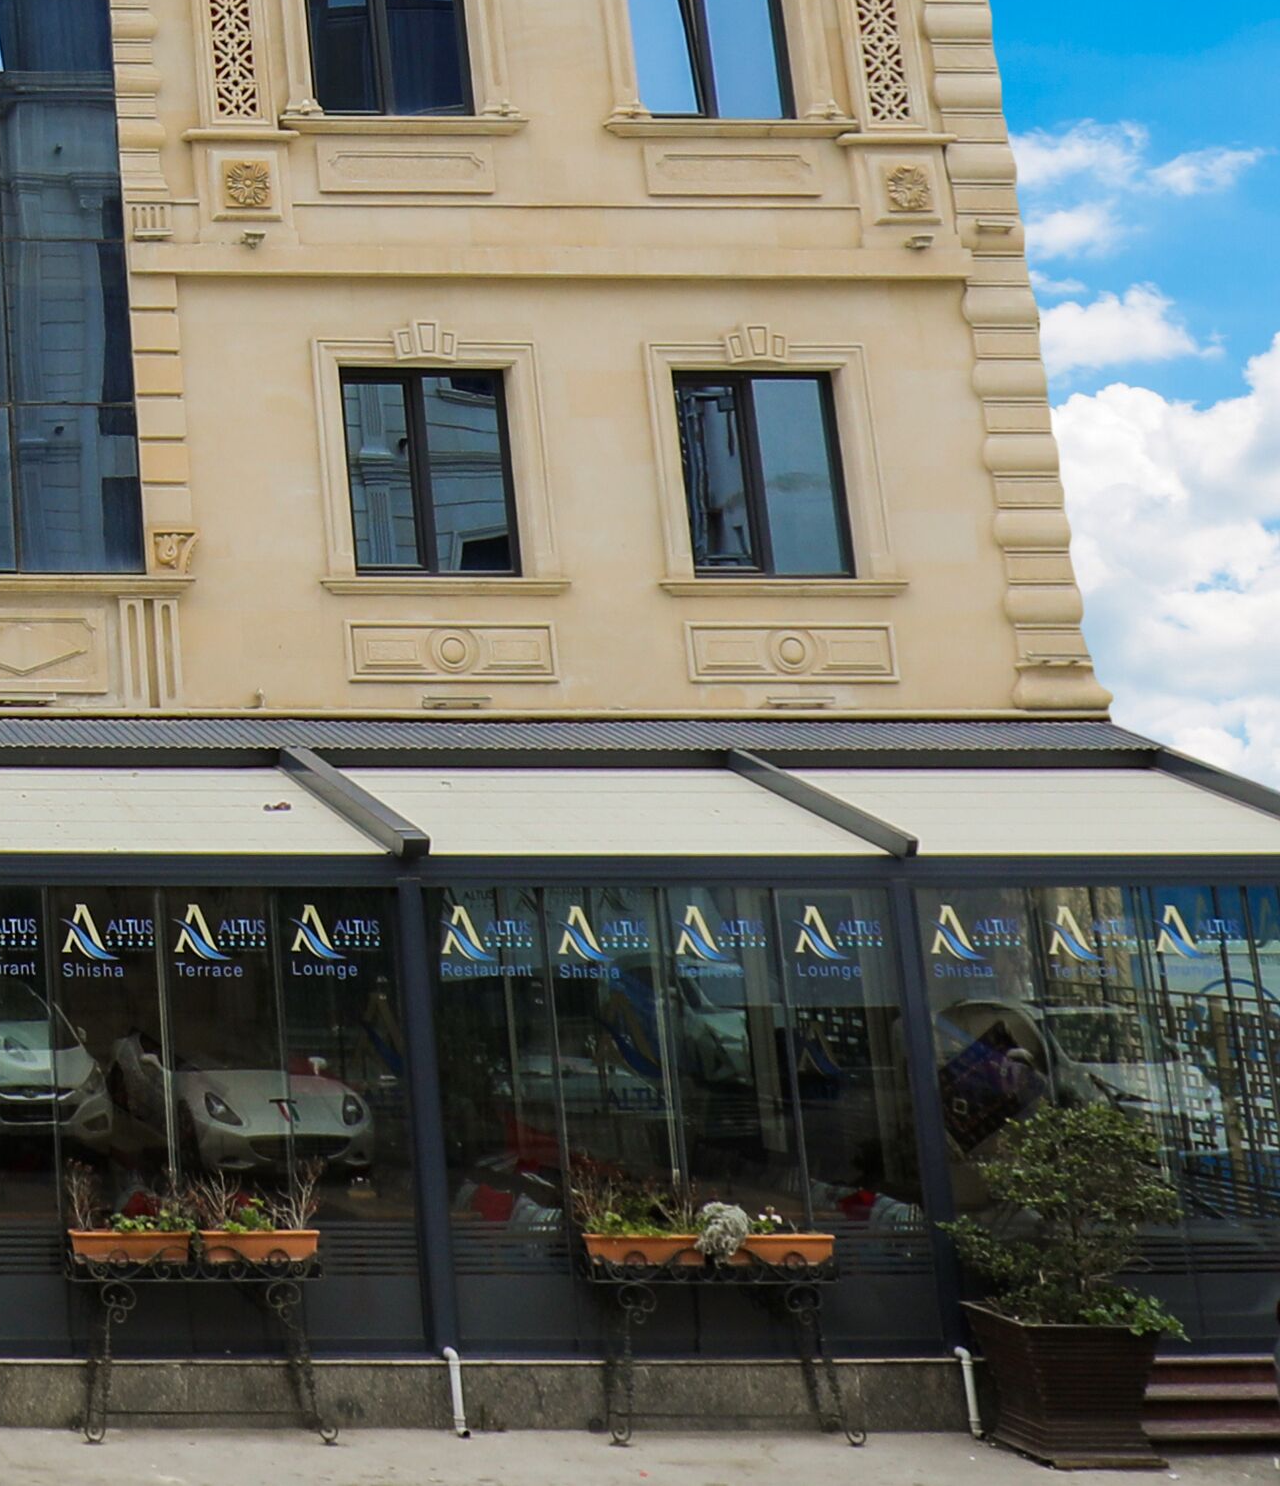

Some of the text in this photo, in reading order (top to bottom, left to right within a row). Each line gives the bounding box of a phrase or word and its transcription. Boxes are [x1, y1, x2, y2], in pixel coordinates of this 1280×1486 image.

[106, 919, 154, 935] ALTUS
[219, 919, 266, 935] ALTUS
[334, 919, 380, 935] ALTUS
[486, 920, 531, 936] ALTUS
[601, 920, 648, 937] ALTUS
[720, 920, 766, 935] ALTUS
[838, 920, 881, 935] ALTUS
[62, 963, 124, 978] Shisha
[174, 962, 243, 978] Terrace
[292, 961, 358, 980] Lounge
[440, 962, 533, 978] Restaurant
[559, 964, 620, 979] Shisha
[797, 963, 861, 980] Lounge
[934, 964, 993, 978] Shisha
